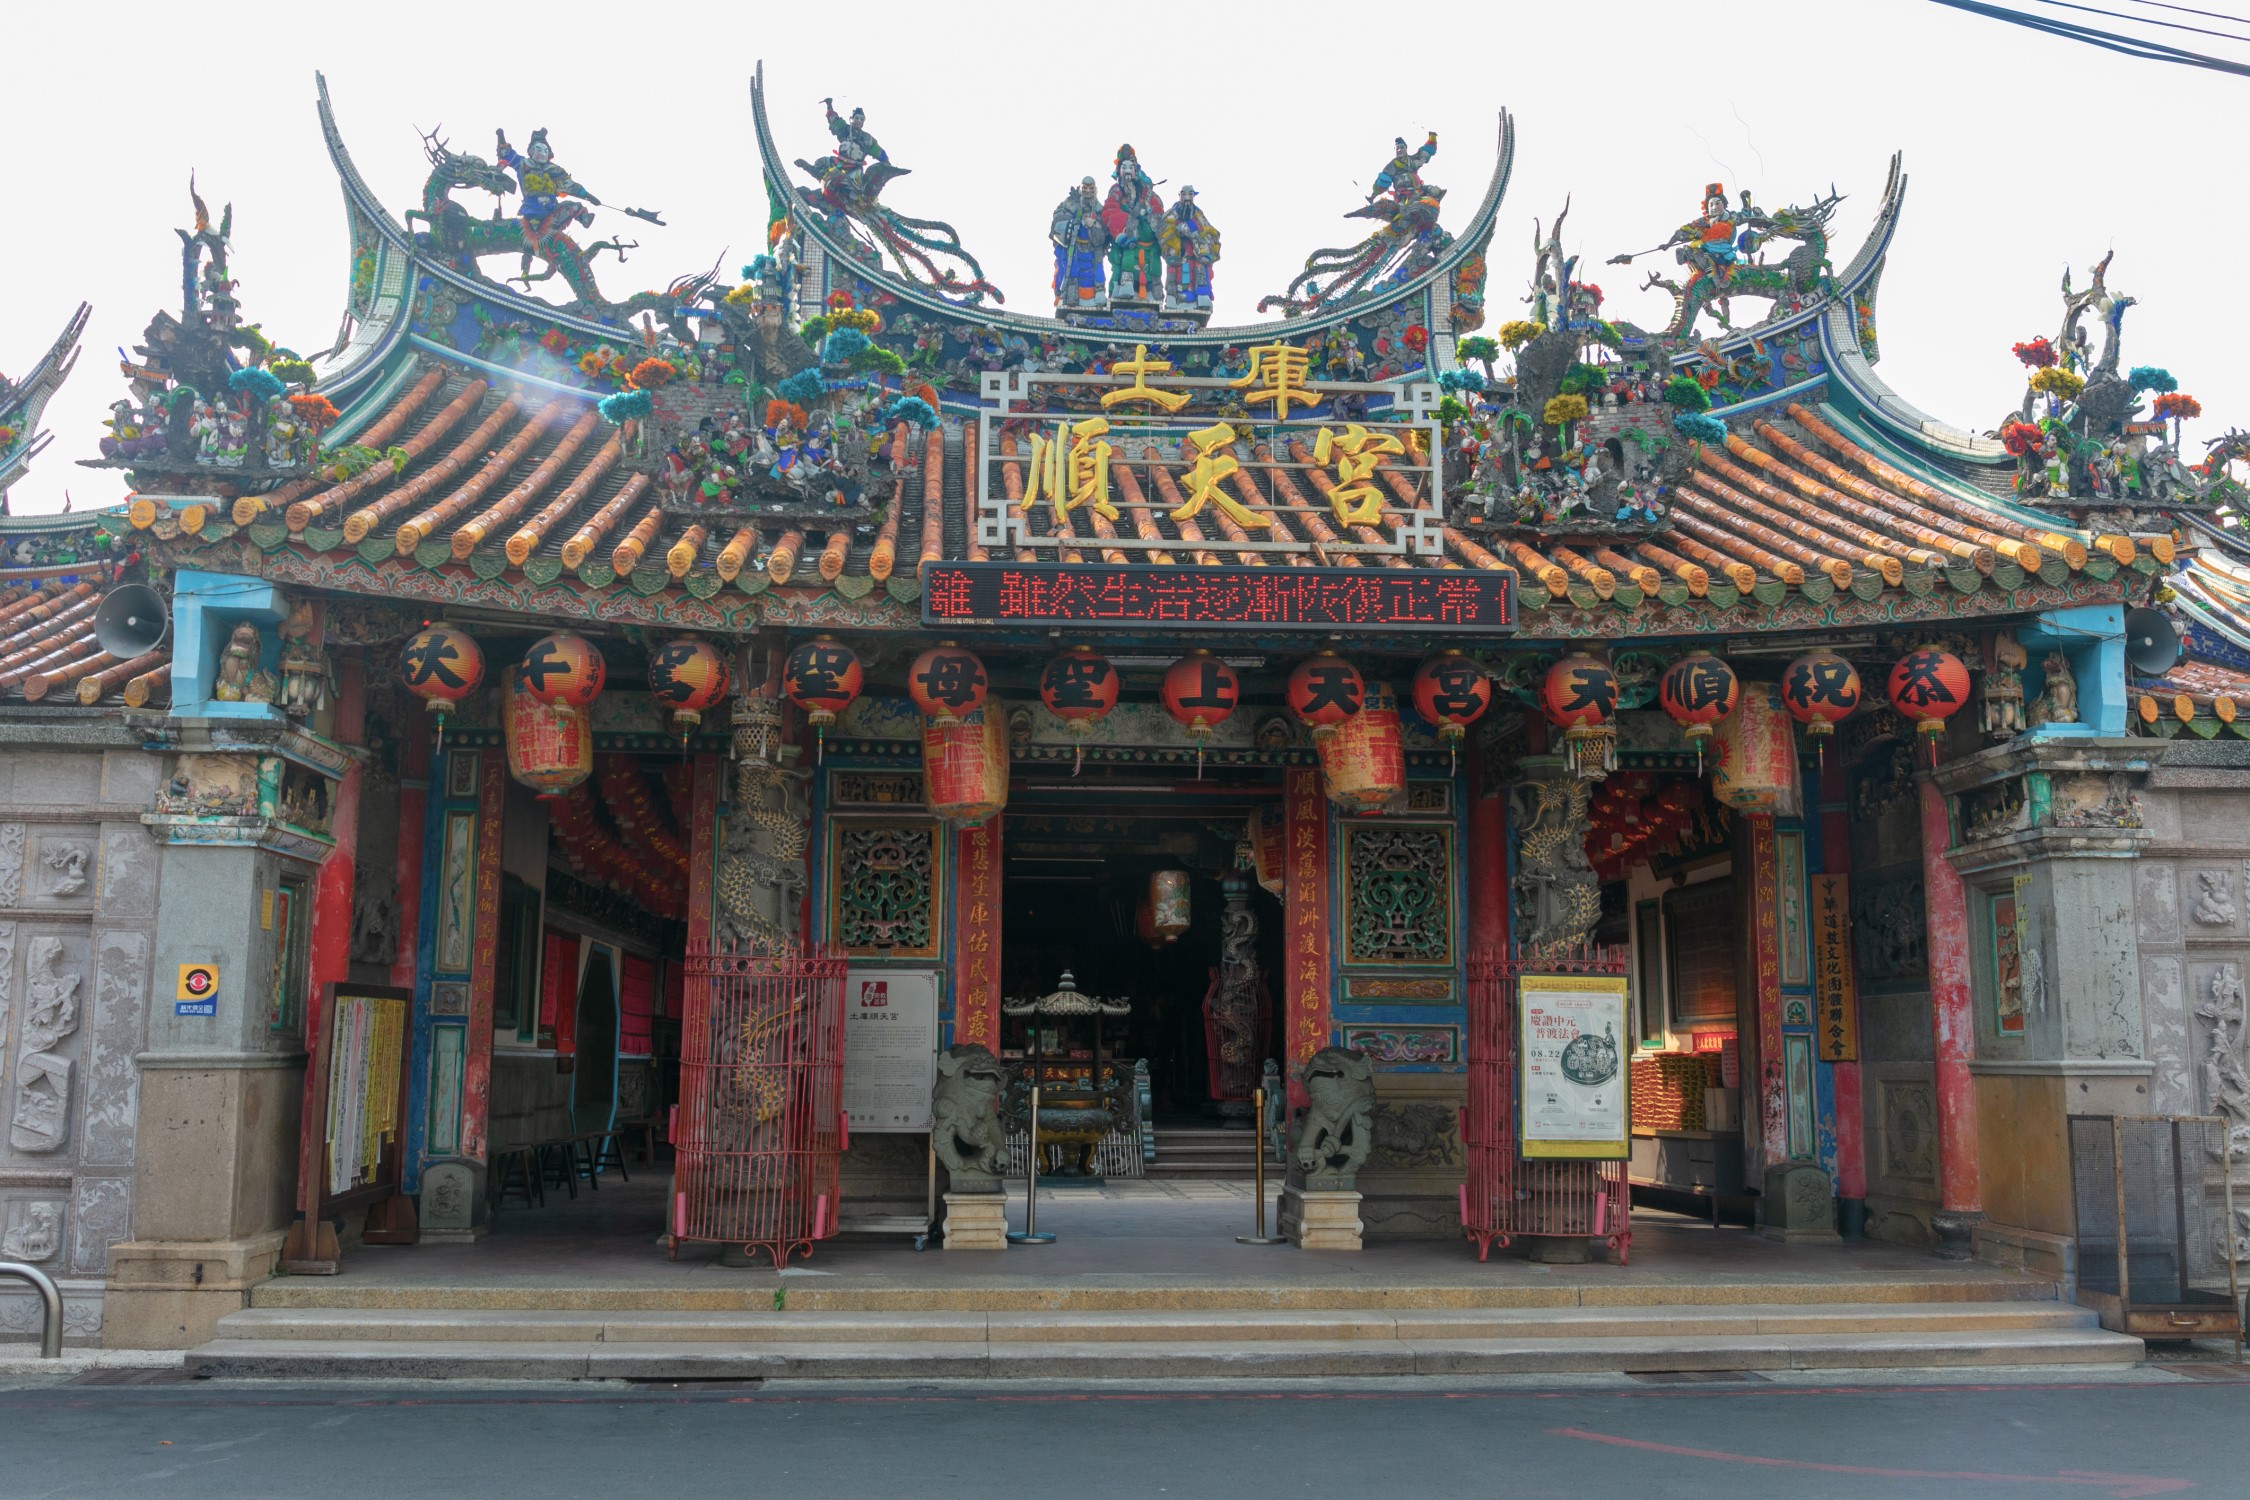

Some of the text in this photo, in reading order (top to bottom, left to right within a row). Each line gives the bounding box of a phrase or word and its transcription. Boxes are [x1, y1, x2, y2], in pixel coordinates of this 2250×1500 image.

[1101, 341, 1323, 421] 土庫
[1021, 417, 1405, 529] 順天宮
[400, 634, 466, 689] 秋
[519, 641, 572, 692] 千
[785, 645, 857, 700] 聖
[916, 655, 985, 707] 母
[1041, 656, 1110, 708] 聖
[1179, 662, 1235, 708] 上
[1667, 660, 1731, 714] 順
[1788, 661, 1856, 708] 祝
[1896, 652, 1957, 706] 恭
[1302, 666, 1360, 714] 天
[1430, 661, 1489, 716] 宮
[849, 1012, 899, 1020] 土庫順天宮
[1536, 1028, 1580, 1040] 普渡法會
[1531, 1050, 1560, 1058] 08.22
